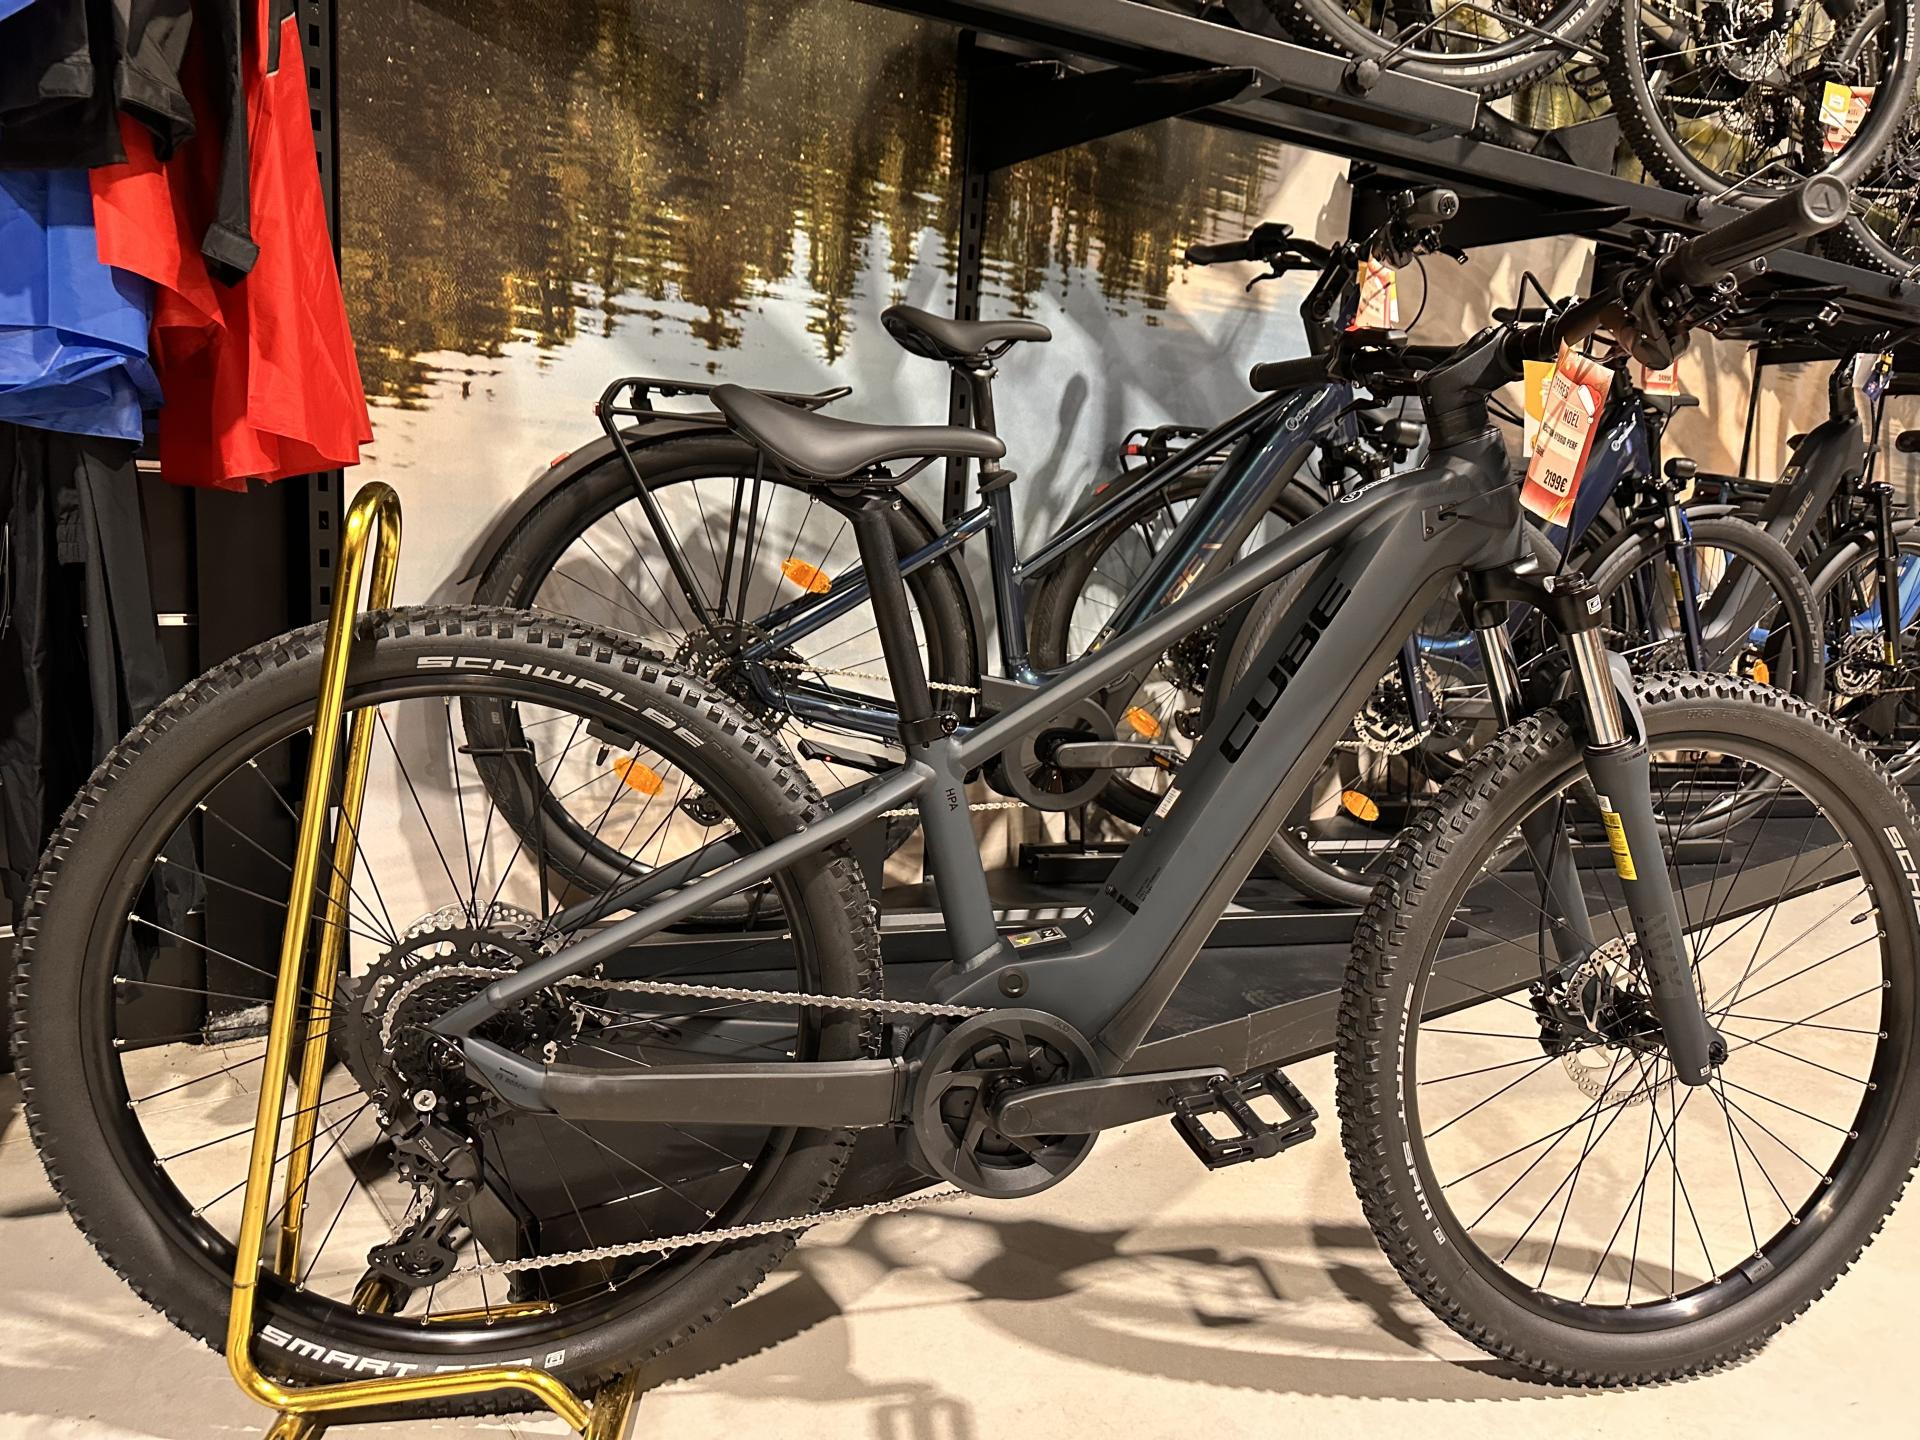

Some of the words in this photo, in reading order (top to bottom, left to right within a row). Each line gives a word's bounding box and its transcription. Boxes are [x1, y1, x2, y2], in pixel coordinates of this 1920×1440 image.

[1904, 0, 1916, 62] SMAR
[1562, 408, 1580, 429] NOËL
[1543, 468, 1568, 493] 2199€
[1779, 489, 1815, 549] CUBE
[1219, 576, 1352, 764] CUBE
[416, 655, 705, 748] SCHWALBE
[945, 787, 959, 812] HPA
[418, 1138, 440, 1163] CUES
[1402, 1140, 1433, 1221] SAM
[257, 1324, 419, 1377] SMART
